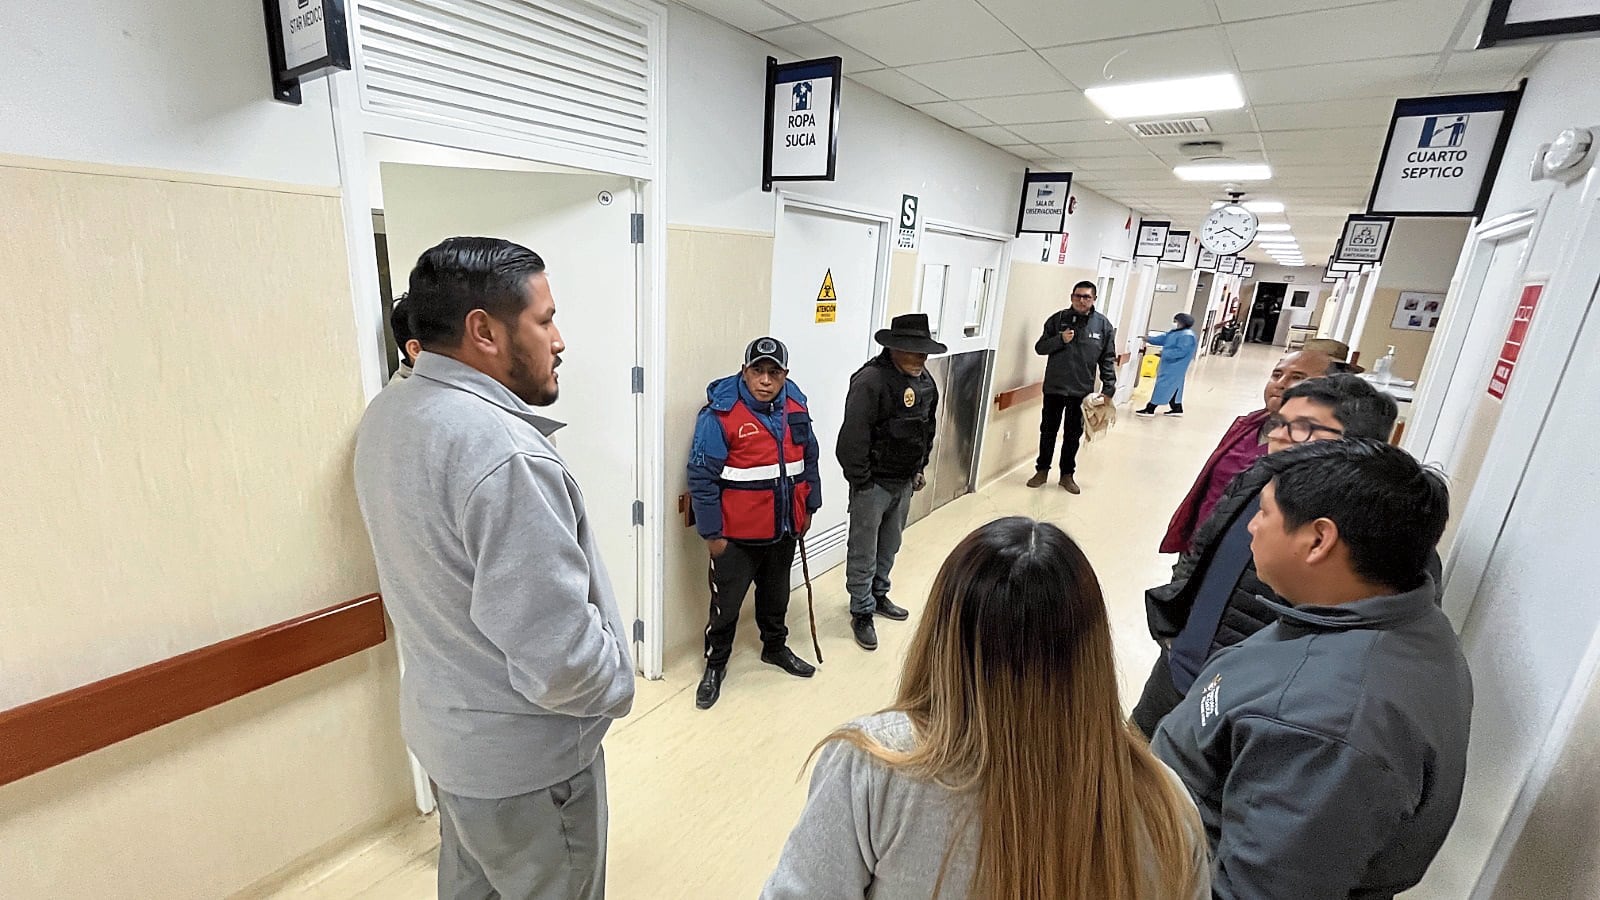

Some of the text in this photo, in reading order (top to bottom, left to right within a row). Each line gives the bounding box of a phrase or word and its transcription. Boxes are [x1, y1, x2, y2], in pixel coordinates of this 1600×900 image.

[788, 113, 815, 129] ROPA
[786, 133, 816, 148] SUCIA
[1407, 150, 1468, 163] CUARTO
[1401, 166, 1464, 179] SEPTICO
[902, 198, 915, 226] S
